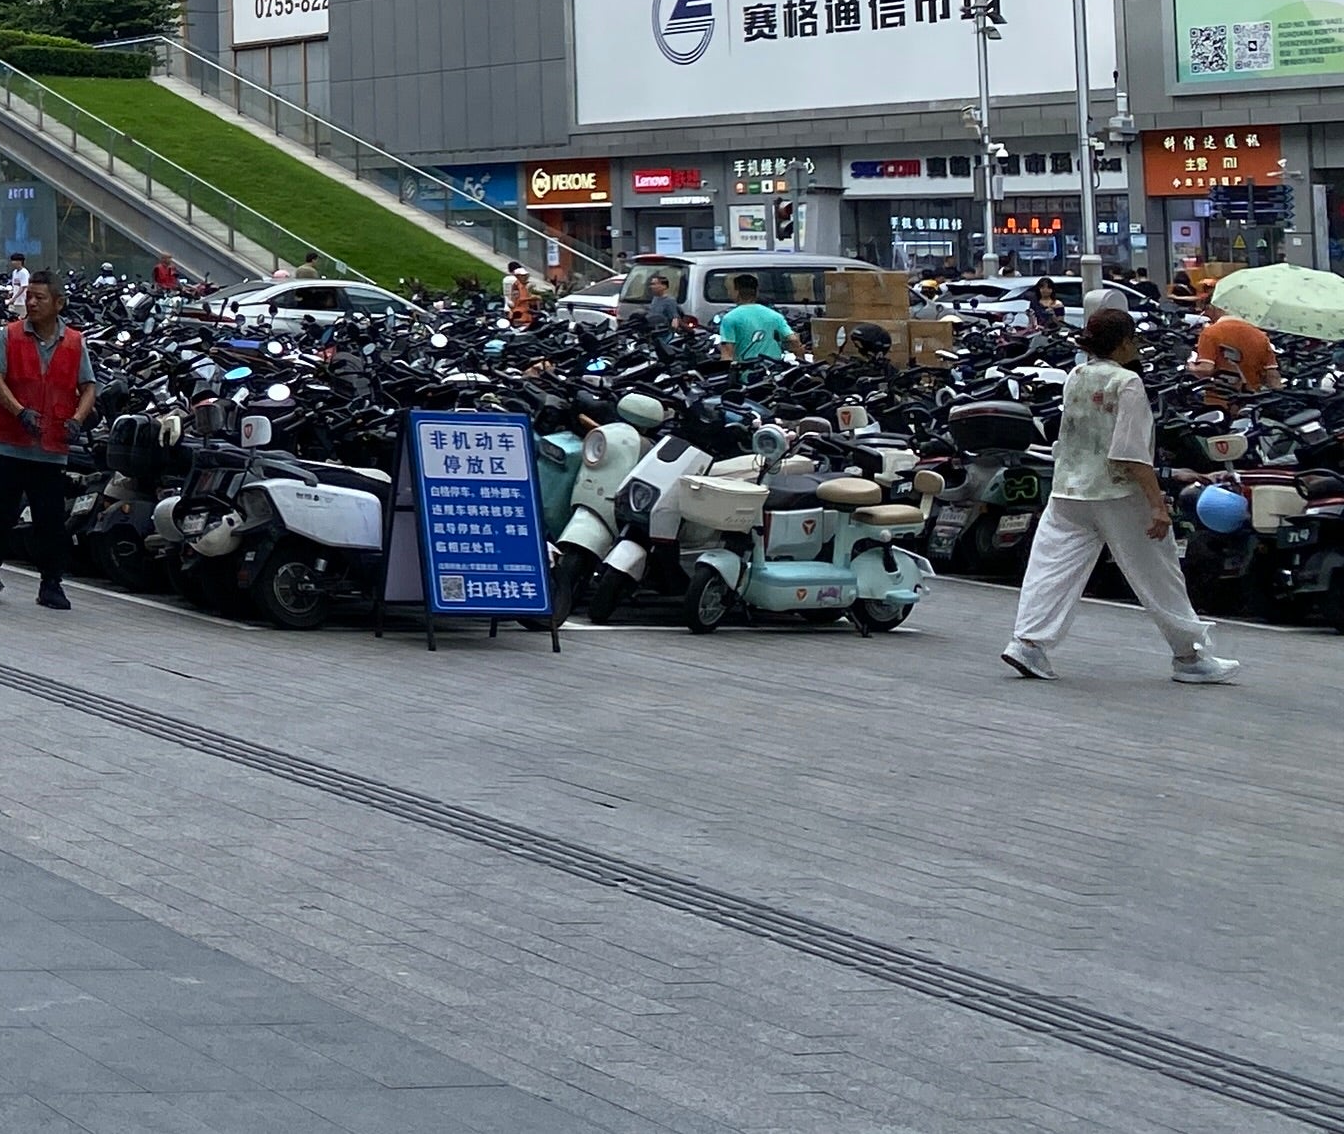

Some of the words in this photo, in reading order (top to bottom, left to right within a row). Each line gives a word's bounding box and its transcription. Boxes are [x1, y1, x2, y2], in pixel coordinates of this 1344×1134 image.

[1185, 157, 1208, 172] 主营
[552, 172, 598, 191] WEKOME
[635, 175, 671, 188] Lenovo
[430, 430, 516, 452] 非机动车
[443, 455, 508, 476] 停放区
[466, 579, 538, 599] 扫码找车
